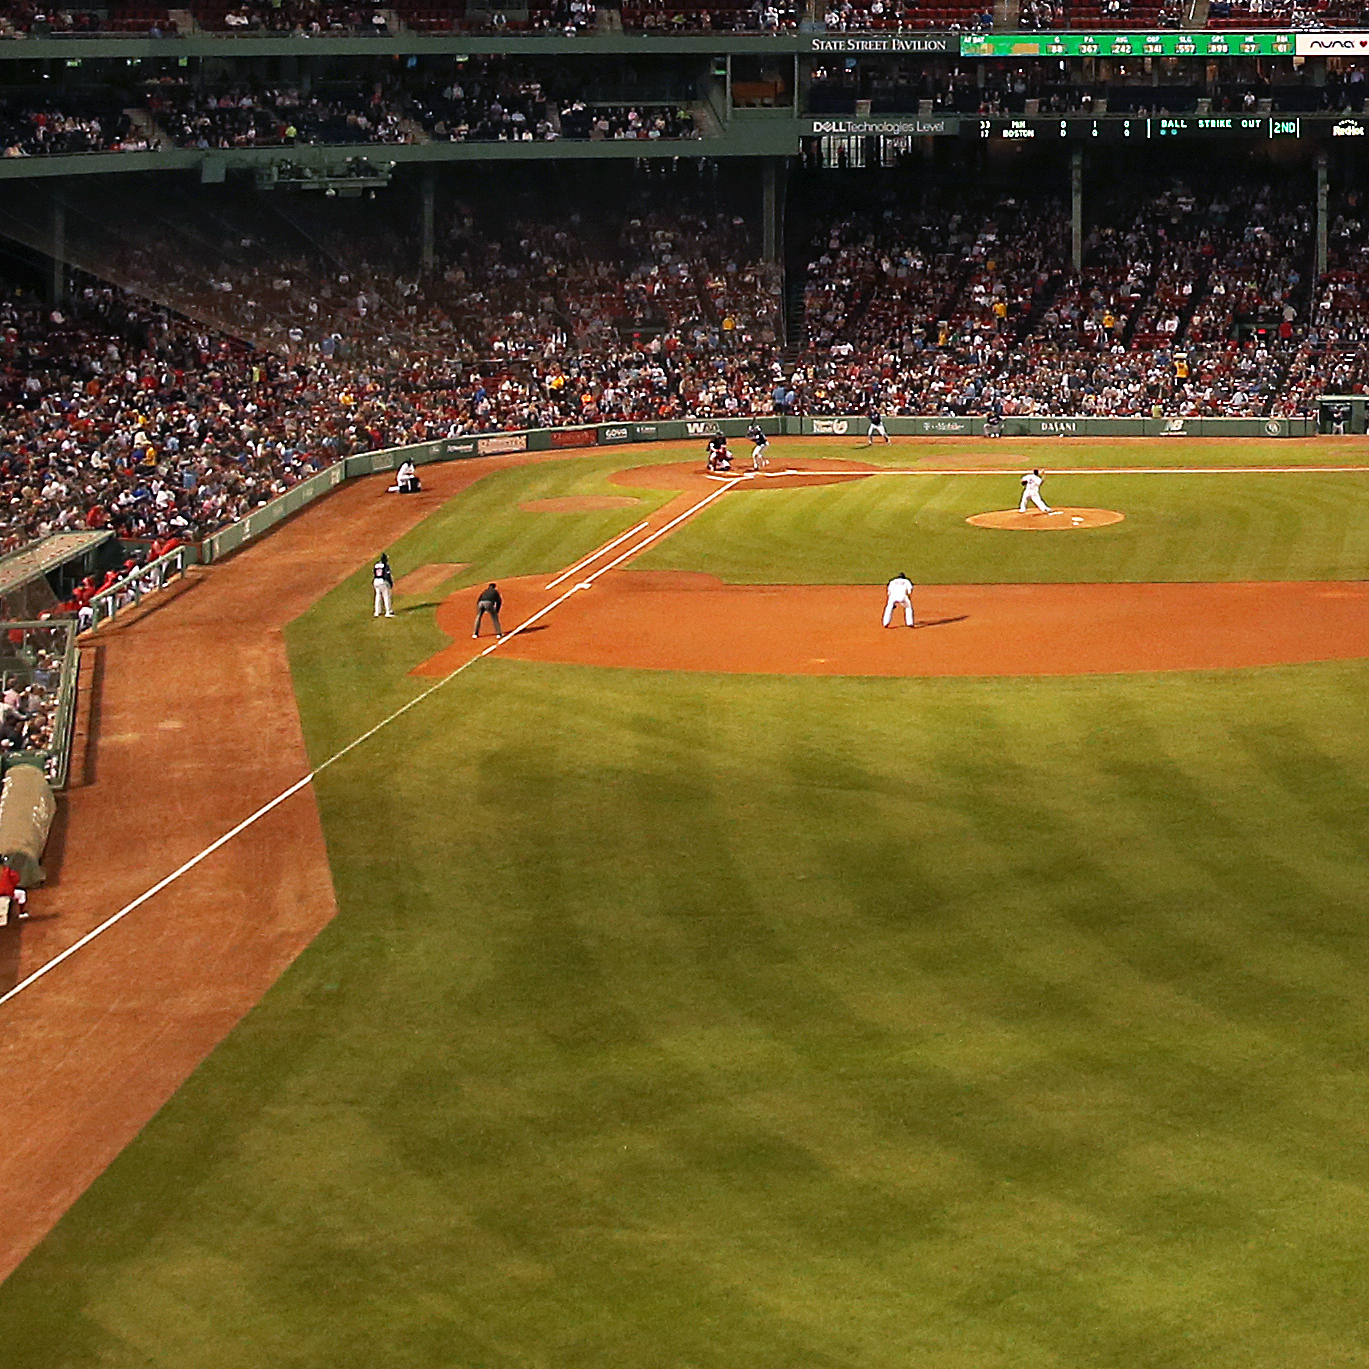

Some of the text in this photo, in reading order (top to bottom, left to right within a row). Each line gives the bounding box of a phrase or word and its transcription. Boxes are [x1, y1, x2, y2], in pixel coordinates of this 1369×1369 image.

[1051, 44, 1063, 53] 88
[1081, 44, 1098, 53] 367
[1244, 44, 1256, 53] 27
[1309, 40, 1355, 49] nuna
[916, 120, 945, 132] Level
[1161, 119, 1262, 128] BALL STRIKE OUT
[1273, 121, 1296, 133] 2ND
[1002, 129, 1035, 138] BOSTON
[1041, 422, 1076, 431] DASANI
